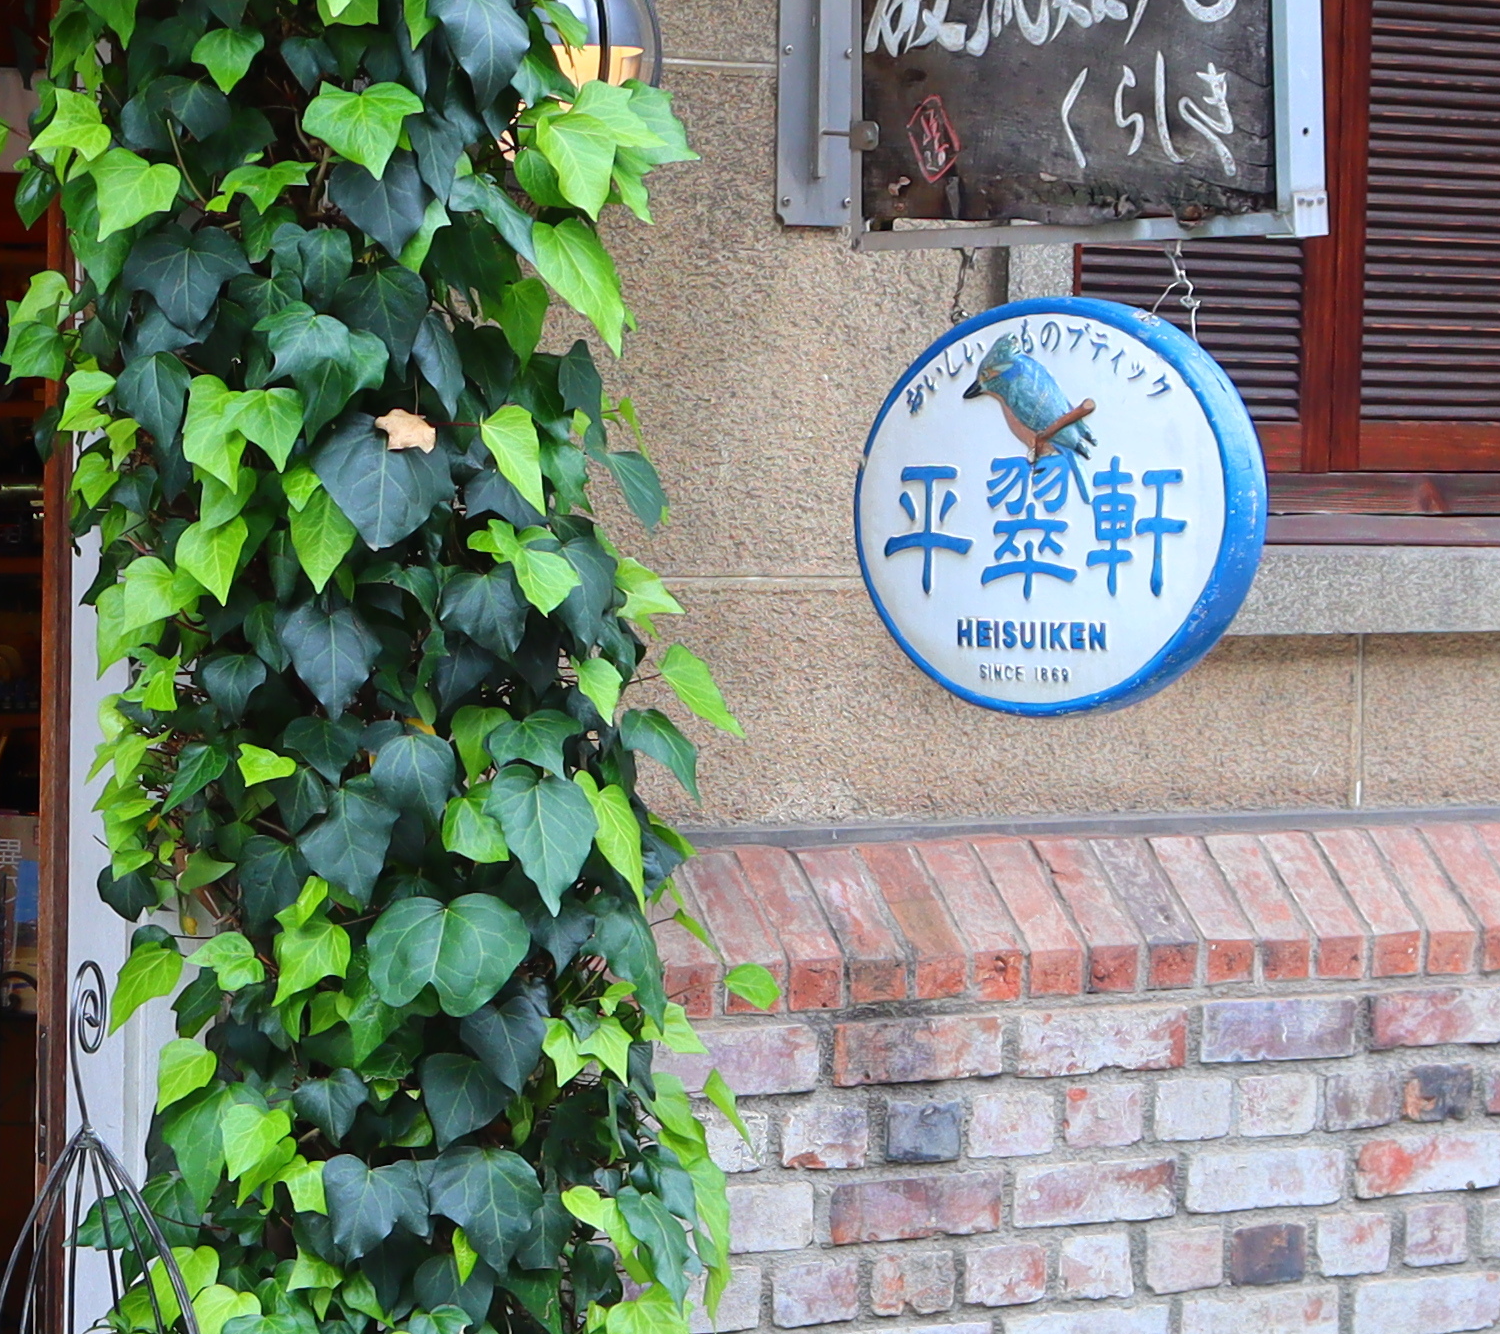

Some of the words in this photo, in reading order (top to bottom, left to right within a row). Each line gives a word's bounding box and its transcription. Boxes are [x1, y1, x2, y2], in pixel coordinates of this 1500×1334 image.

[1060, 50, 1236, 176] くらしき
[883, 456, 1187, 600] 平翠軒
[957, 619, 1108, 651] HEISUIKEN
[979, 663, 1026, 681] SINCE
[1034, 665, 1071, 683] 1869
